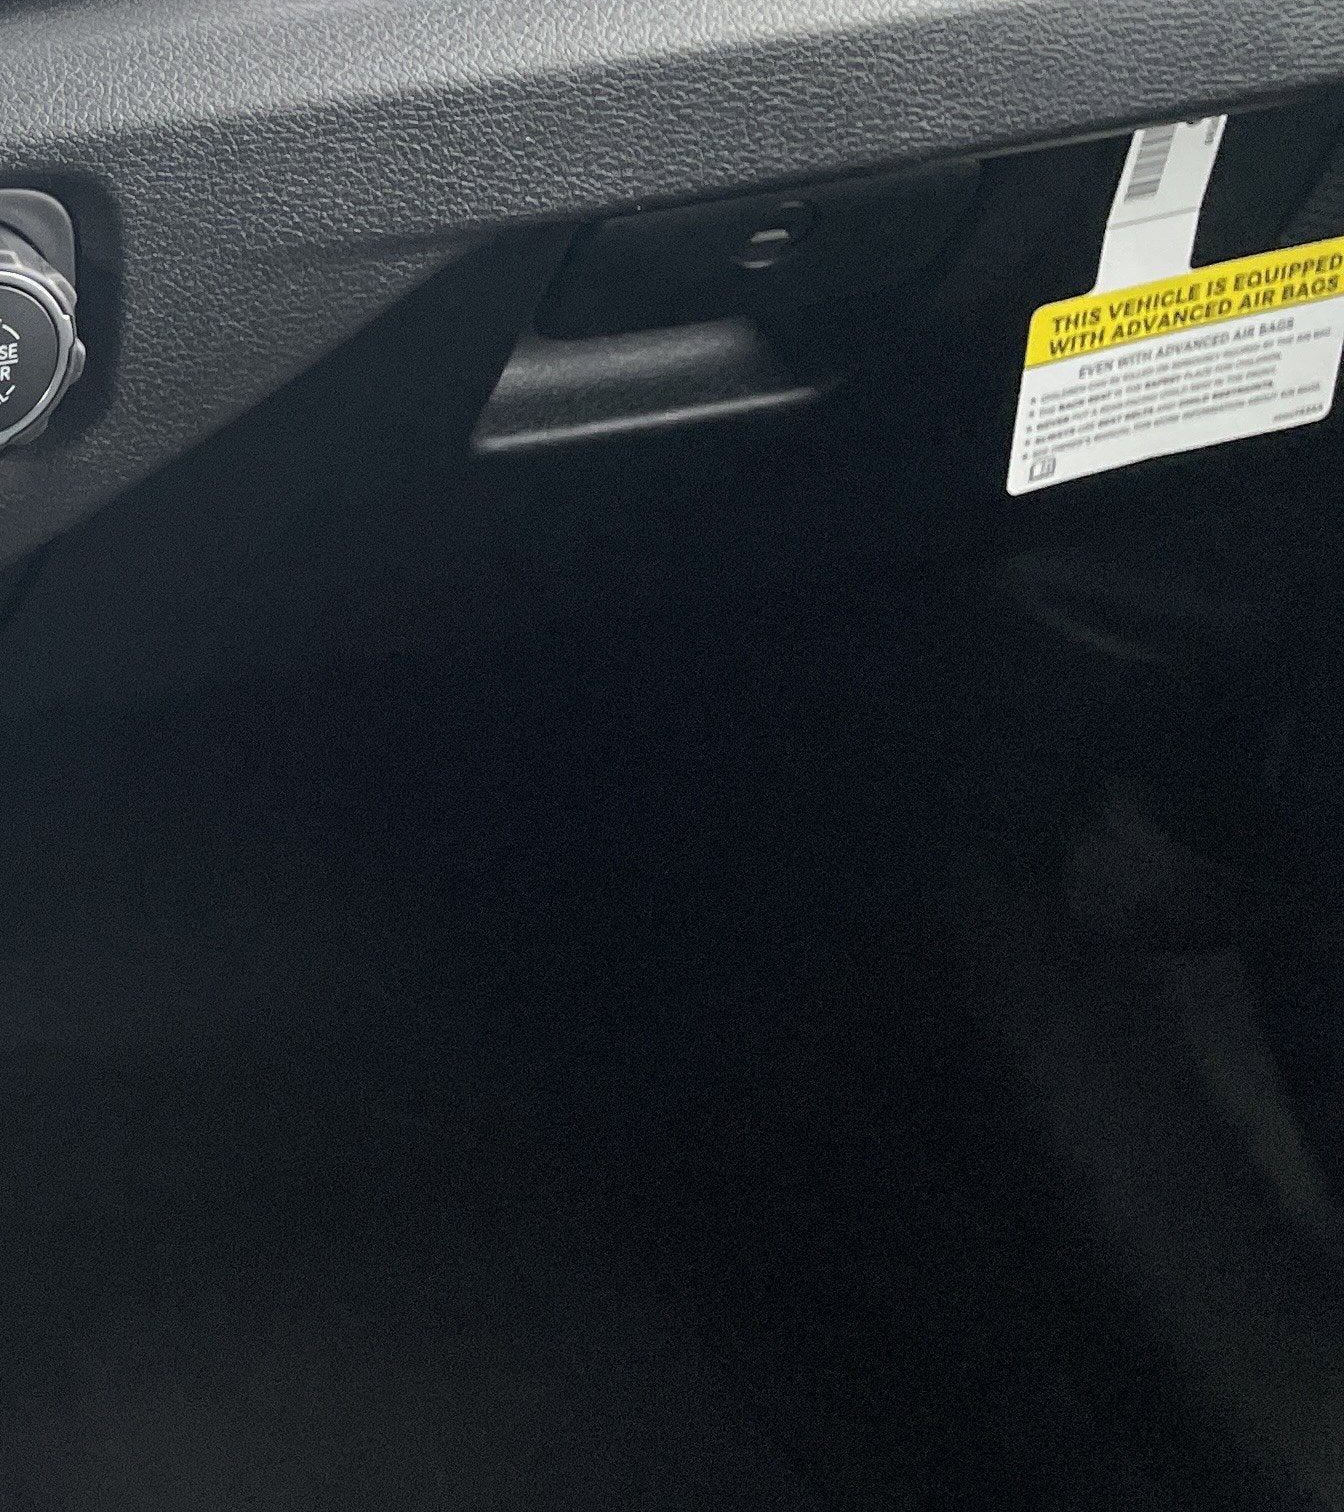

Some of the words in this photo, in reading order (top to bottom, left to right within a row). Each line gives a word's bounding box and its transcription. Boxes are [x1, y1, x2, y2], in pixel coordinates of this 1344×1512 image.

[1049, 328, 1104, 356] WITH
[1112, 299, 1232, 339] ADVANCED
[1238, 289, 1274, 310] AIR
[1282, 275, 1339, 301] BAGS
[1052, 308, 1100, 335] THIS
[1108, 283, 1199, 319] VEHICLE
[1207, 277, 1227, 294] IS
[1233, 253, 1343, 290] EQUIPPED
